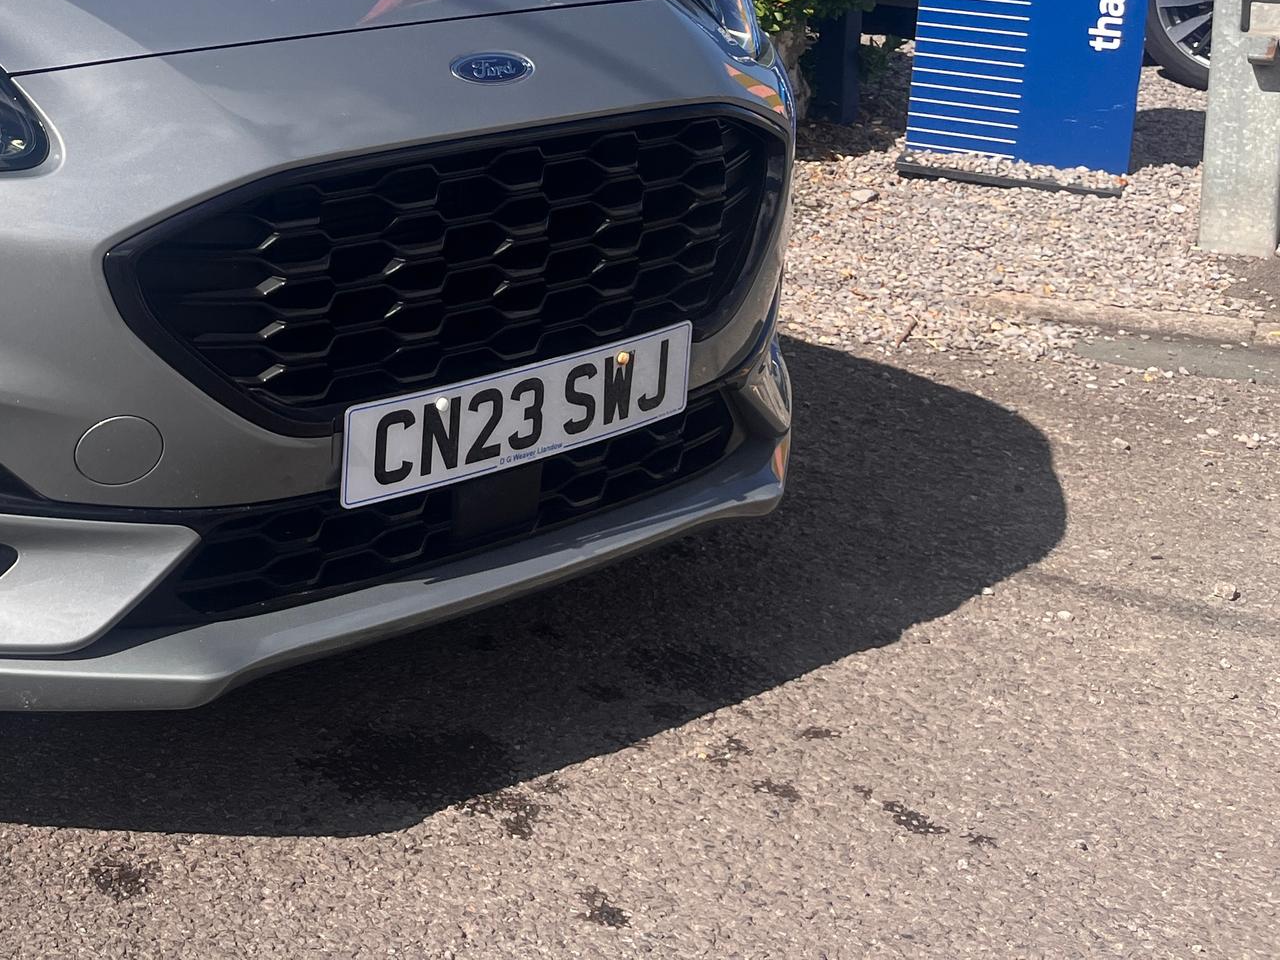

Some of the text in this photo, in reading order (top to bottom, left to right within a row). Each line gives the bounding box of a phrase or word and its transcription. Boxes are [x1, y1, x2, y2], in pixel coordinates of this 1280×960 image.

[471, 59, 516, 79] Ford
[374, 339, 669, 486] CN23 SWJ
[513, 450, 536, 461] Weaver
